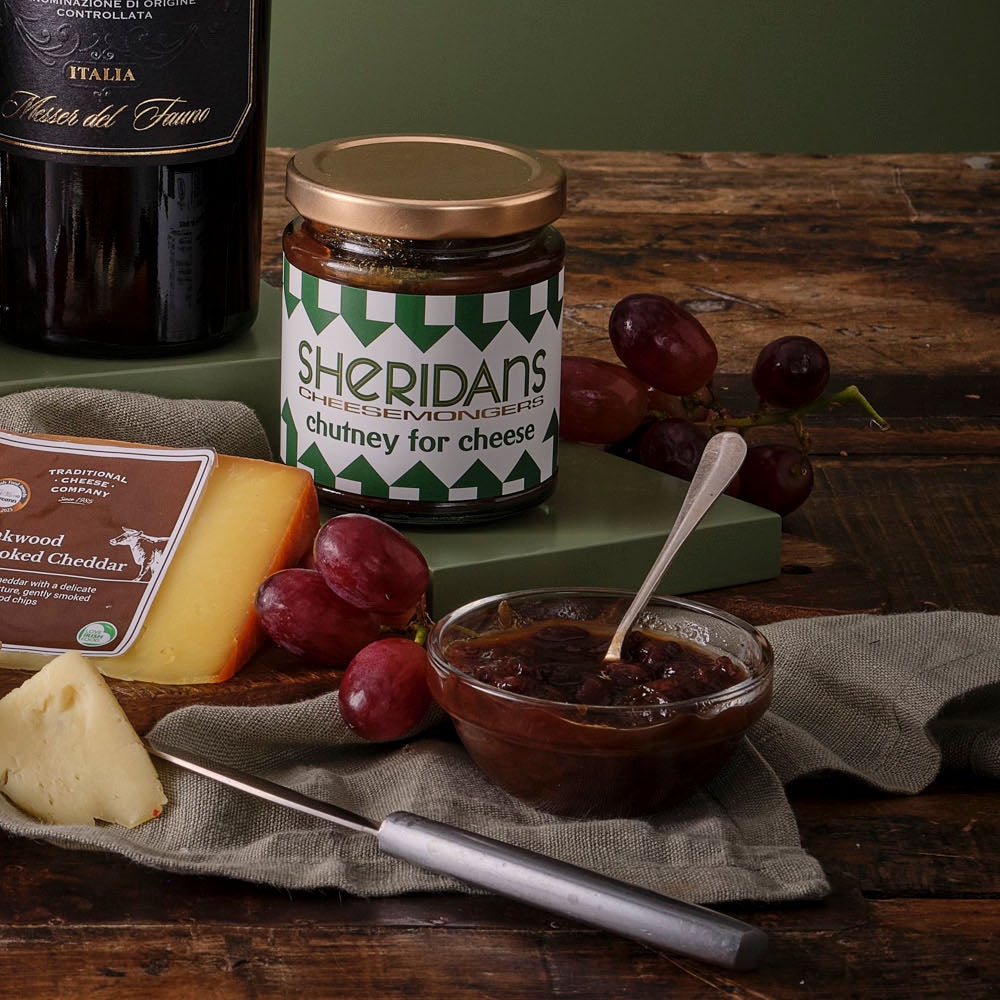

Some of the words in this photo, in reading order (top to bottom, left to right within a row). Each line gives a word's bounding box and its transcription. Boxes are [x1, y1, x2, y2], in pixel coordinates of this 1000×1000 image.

[126, 0, 139, 8] DI
[57, 8, 153, 20] CONTROLLATA
[69, 65, 135, 81] ITALIA
[1, 90, 80, 126] Messer
[82, 104, 129, 128] del
[133, 96, 211, 131] Fauno
[298, 386, 545, 421] CHEESEMONGERS
[306, 411, 400, 455] chutney
[408, 429, 450, 452] for
[458, 423, 535, 451] cheese
[48, 469, 127, 483] TRADITIONAL
[60, 477, 110, 488] CHEESE
[50, 486, 110, 498] COMPANY
[47, 552, 128, 572] Cheddar
[30, 578, 50, 589] with
[60, 582, 97, 594] delicate
[12, 594, 38, 606] chips
[22, 588, 52, 600] gently
[53, 592, 91, 602] smoked
